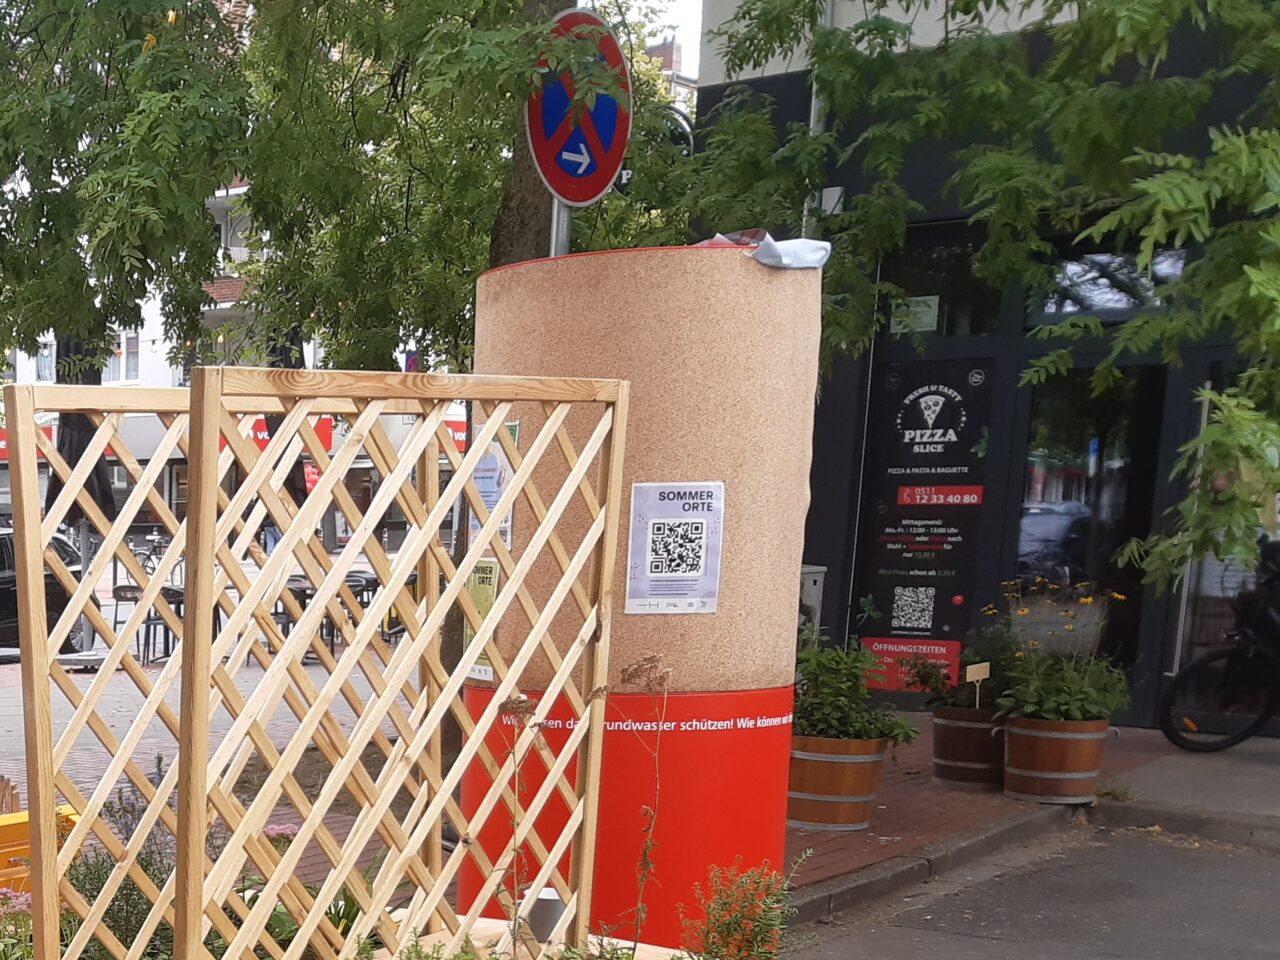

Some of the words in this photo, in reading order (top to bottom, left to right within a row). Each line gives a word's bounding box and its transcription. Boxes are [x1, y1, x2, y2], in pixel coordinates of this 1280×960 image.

[903, 385, 930, 405] FRESH
[938, 384, 963, 402] TASTY
[903, 429, 958, 443] PIZZA
[913, 444, 944, 453] SLICE
[936, 466, 969, 474] BAGUETTE
[658, 491, 714, 501] SOMMER
[914, 487, 935, 495] 0511
[915, 495, 928, 504] 12
[930, 495, 944, 503] 33
[946, 495, 961, 503] 40
[963, 494, 978, 503] 80
[682, 502, 714, 512] ORTE
[473, 565, 493, 575] OMMER
[478, 576, 492, 586] ORTE
[872, 642, 947, 654] ÖFFNUNGSZEITEN
[566, 718, 580, 729] da
[603, 719, 677, 731] rundwasser
[680, 718, 734, 731] schützen!
[736, 717, 755, 729] Wie
[756, 715, 782, 728] können
